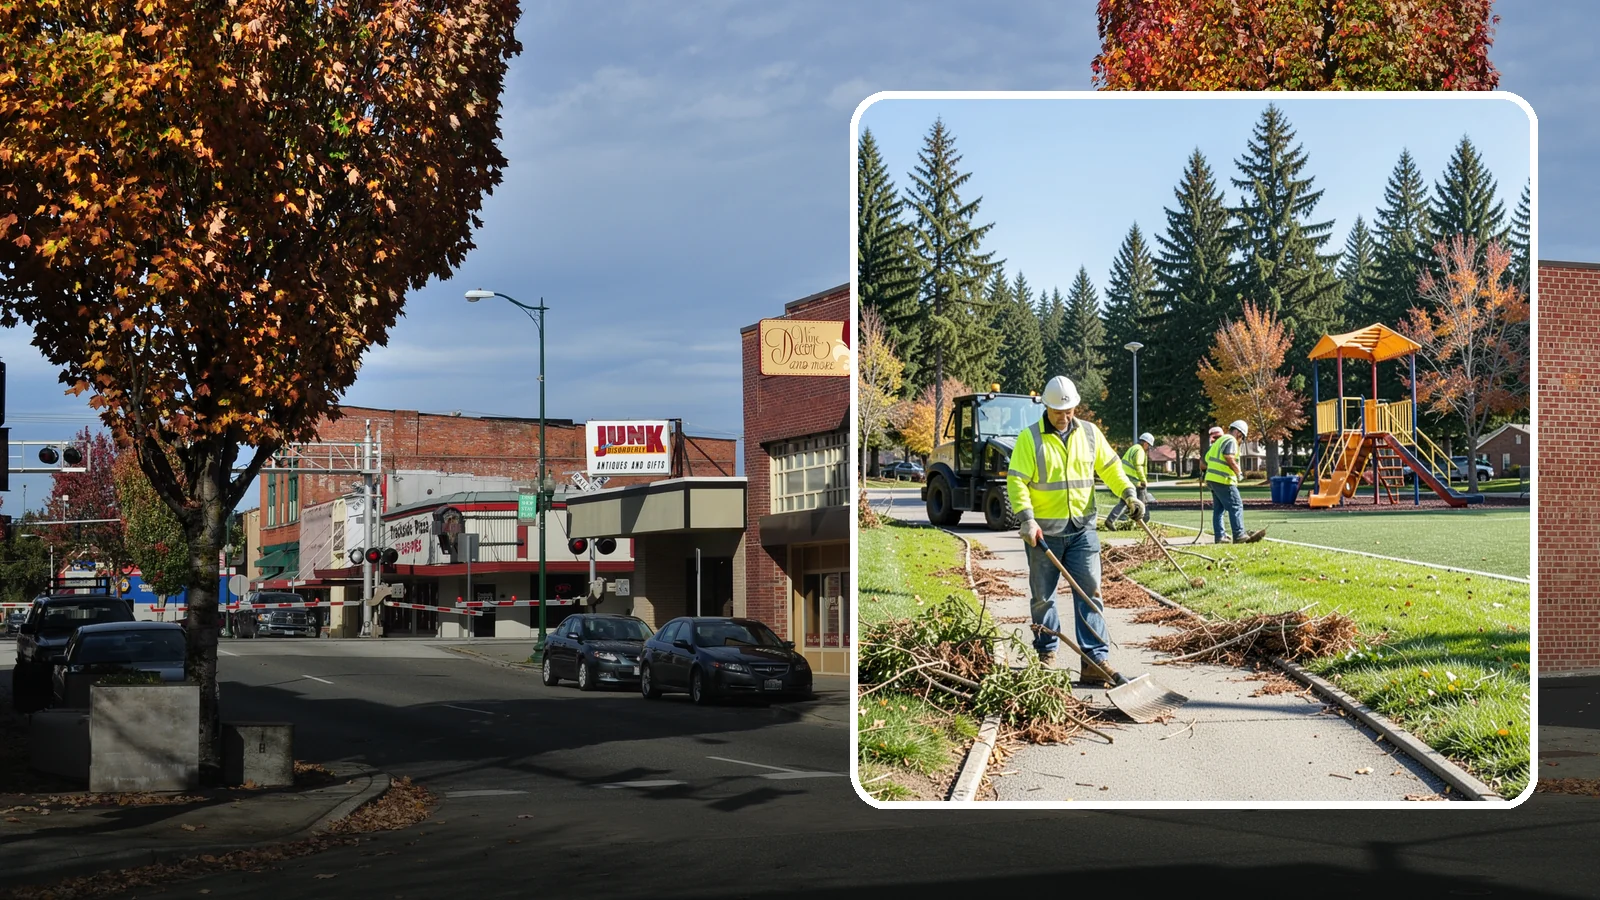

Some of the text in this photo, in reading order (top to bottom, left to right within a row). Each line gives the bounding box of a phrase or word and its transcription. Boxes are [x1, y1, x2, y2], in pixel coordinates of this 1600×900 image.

[595, 425, 665, 457] JUNK
[607, 446, 645, 454] DISORDERLY
[597, 461, 665, 470] ANTIQUES AND GIFTS
[573, 473, 588, 491] RAIL
[415, 519, 429, 535] Pizza
